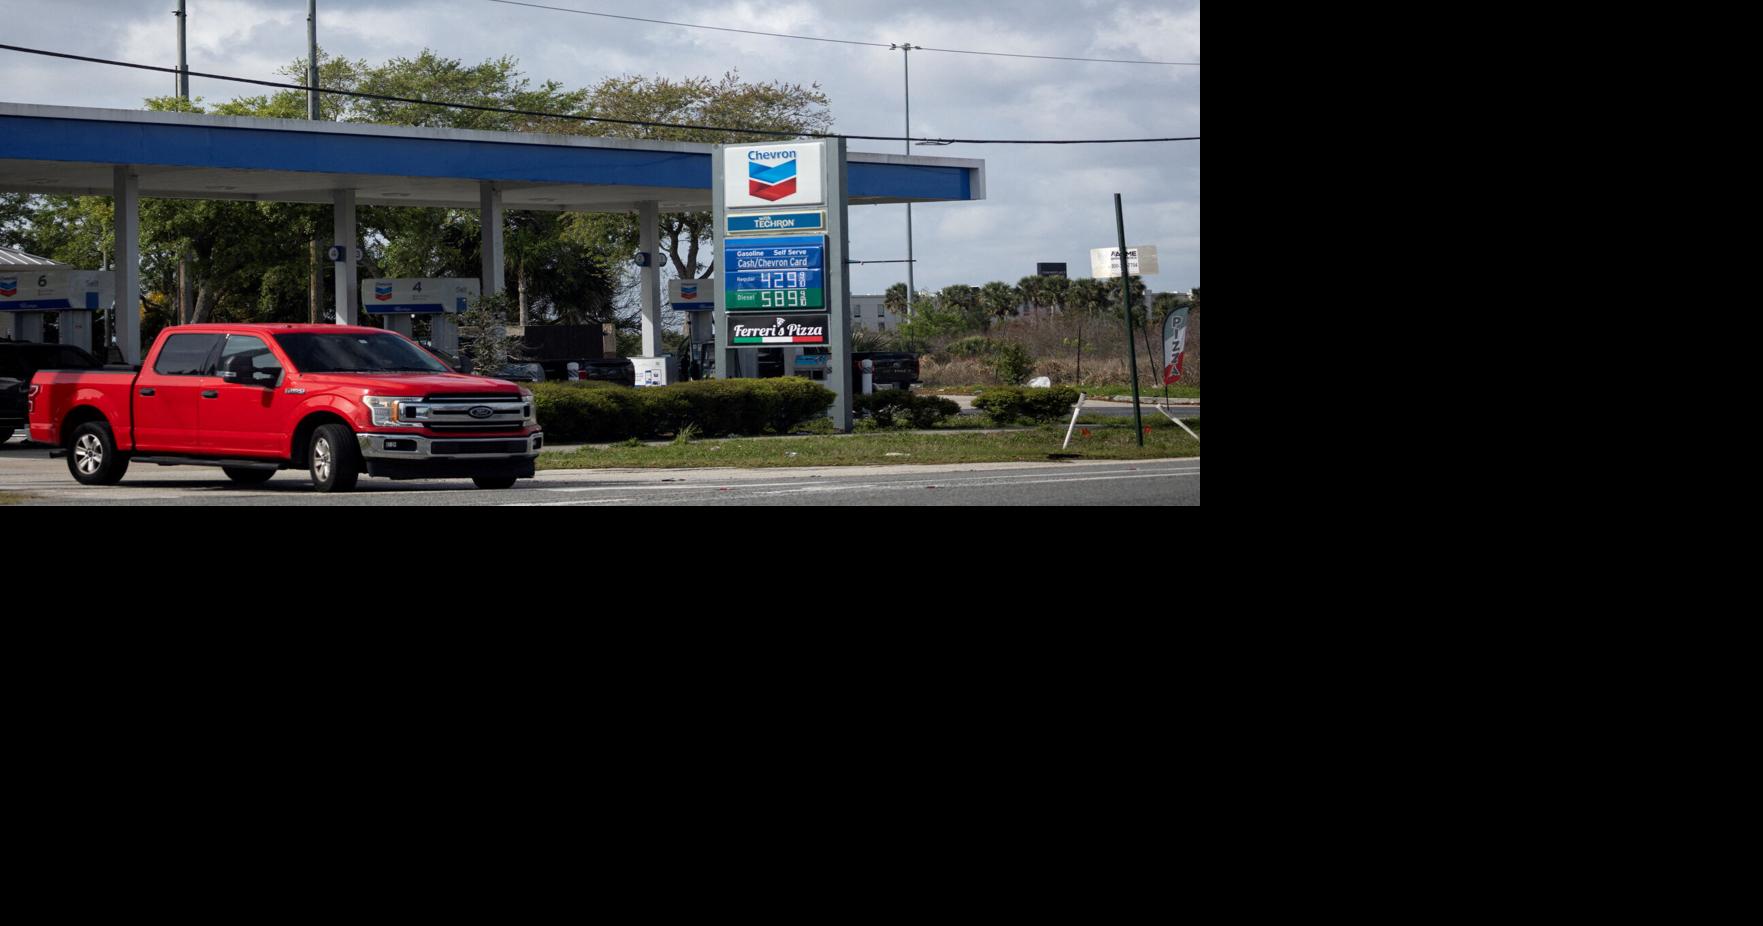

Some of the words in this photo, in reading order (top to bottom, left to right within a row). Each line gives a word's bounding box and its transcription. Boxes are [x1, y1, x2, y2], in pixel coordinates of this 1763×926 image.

[748, 150, 797, 160] Chevron
[754, 220, 795, 228] TECHRON
[738, 259, 788, 268] Cash/Chevron
[790, 257, 807, 266] Card
[38, 275, 47, 287] 6
[761, 271, 797, 288] 429
[412, 281, 422, 293] 4
[761, 290, 798, 307] 589
[733, 324, 785, 337] Ferreri's
[786, 323, 823, 336] Pizza
[1172, 317, 1182, 377] PIZZA
